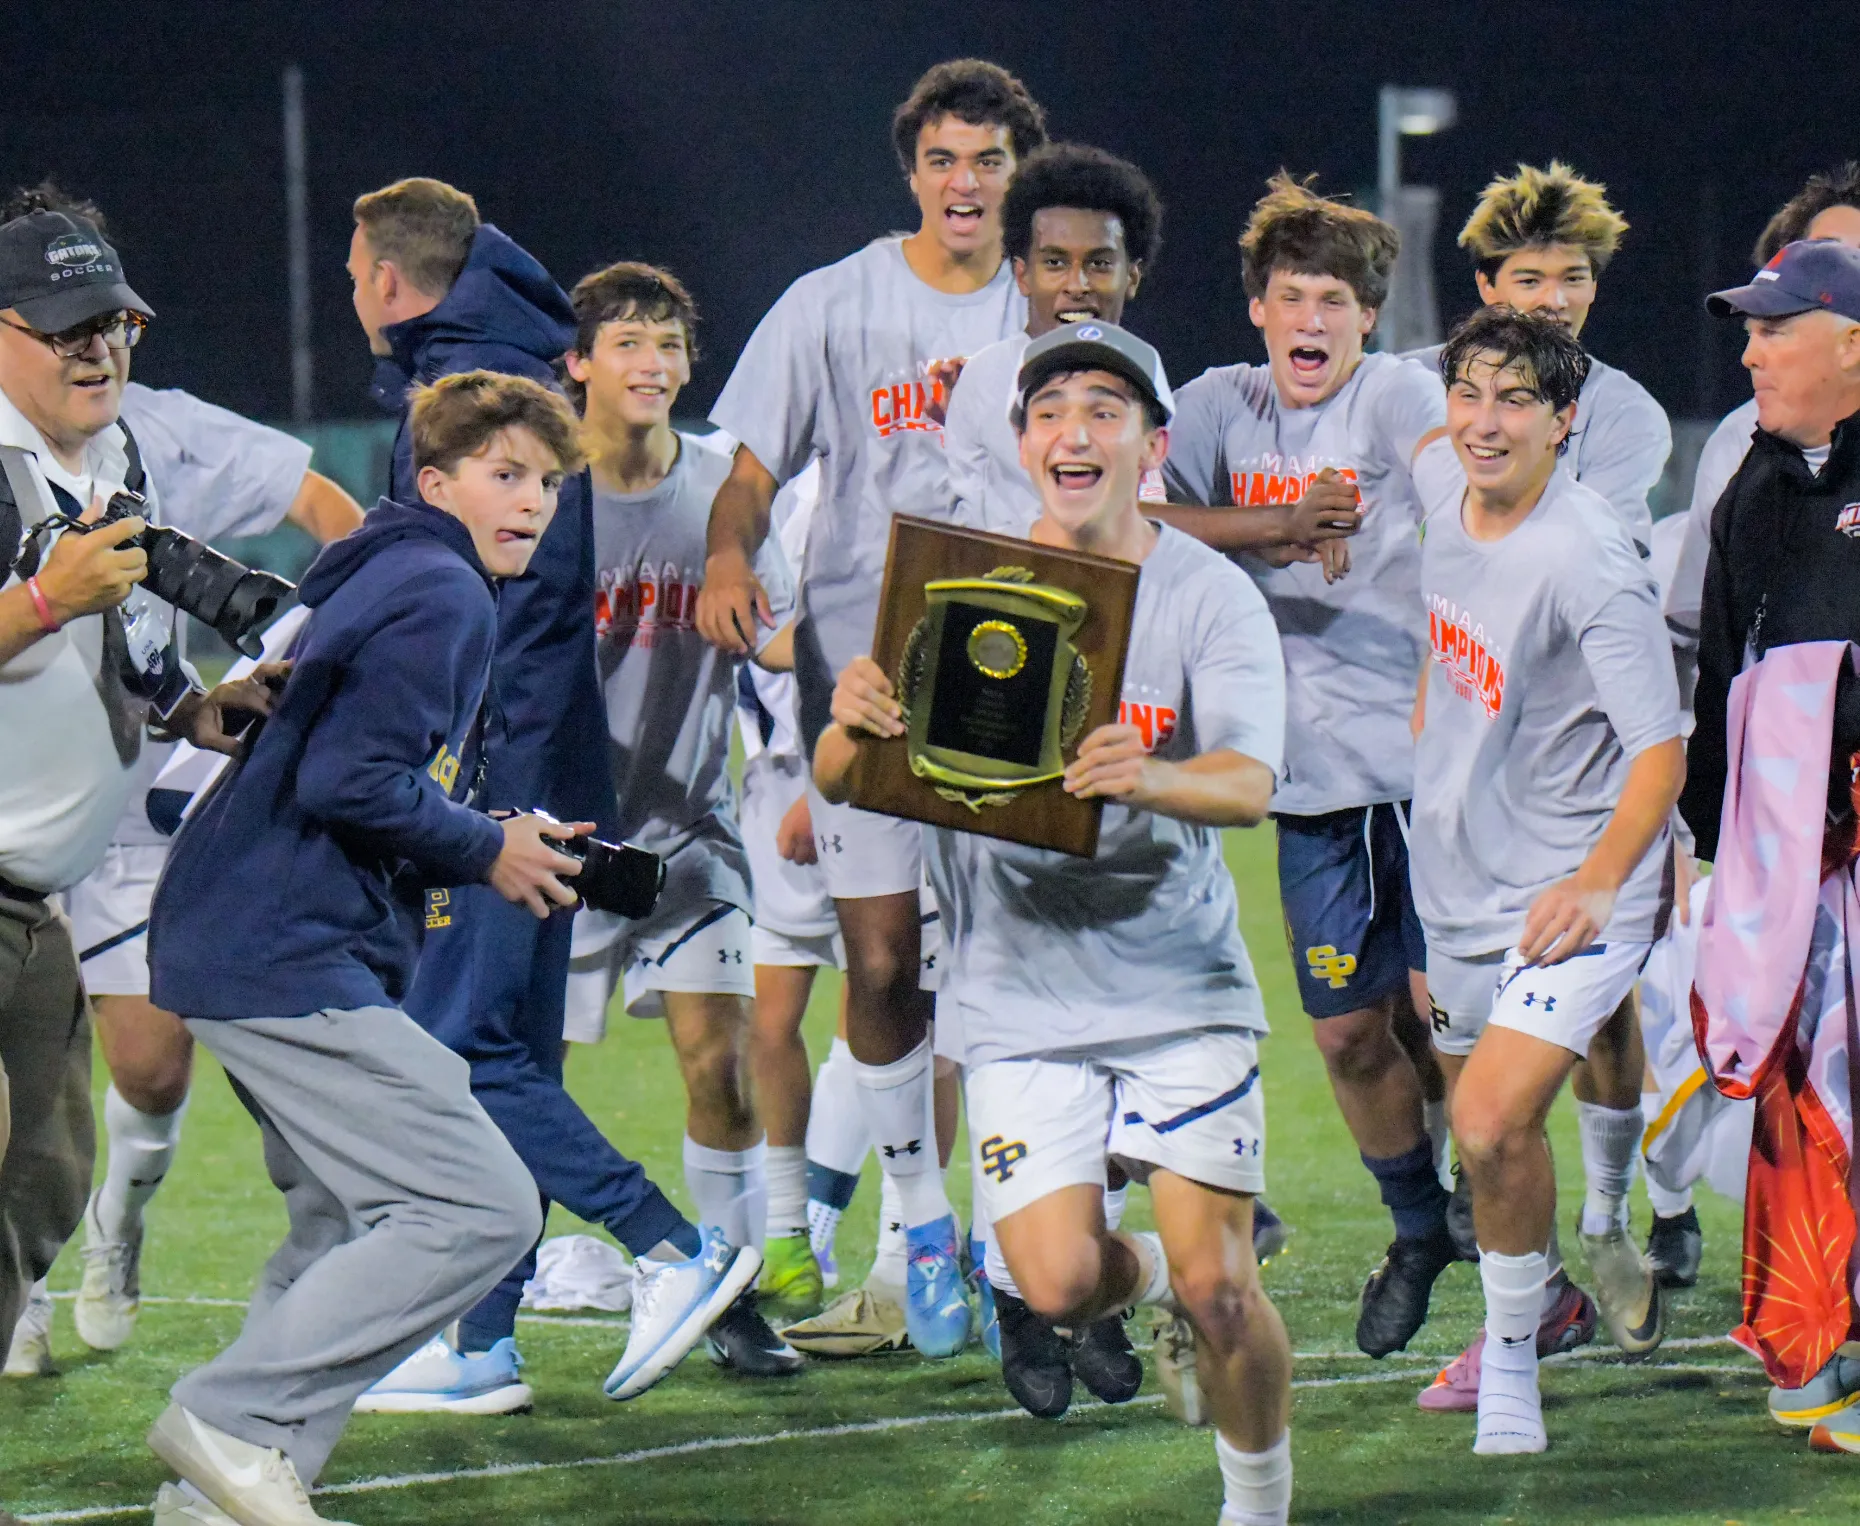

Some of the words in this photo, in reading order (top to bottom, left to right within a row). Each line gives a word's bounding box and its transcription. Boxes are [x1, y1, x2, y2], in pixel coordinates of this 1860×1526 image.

[50, 264, 113, 281] SOCCER
[1432, 593, 1485, 644] MIAA
[1305, 944, 1358, 989] SP
[980, 1134, 1027, 1184] SP
